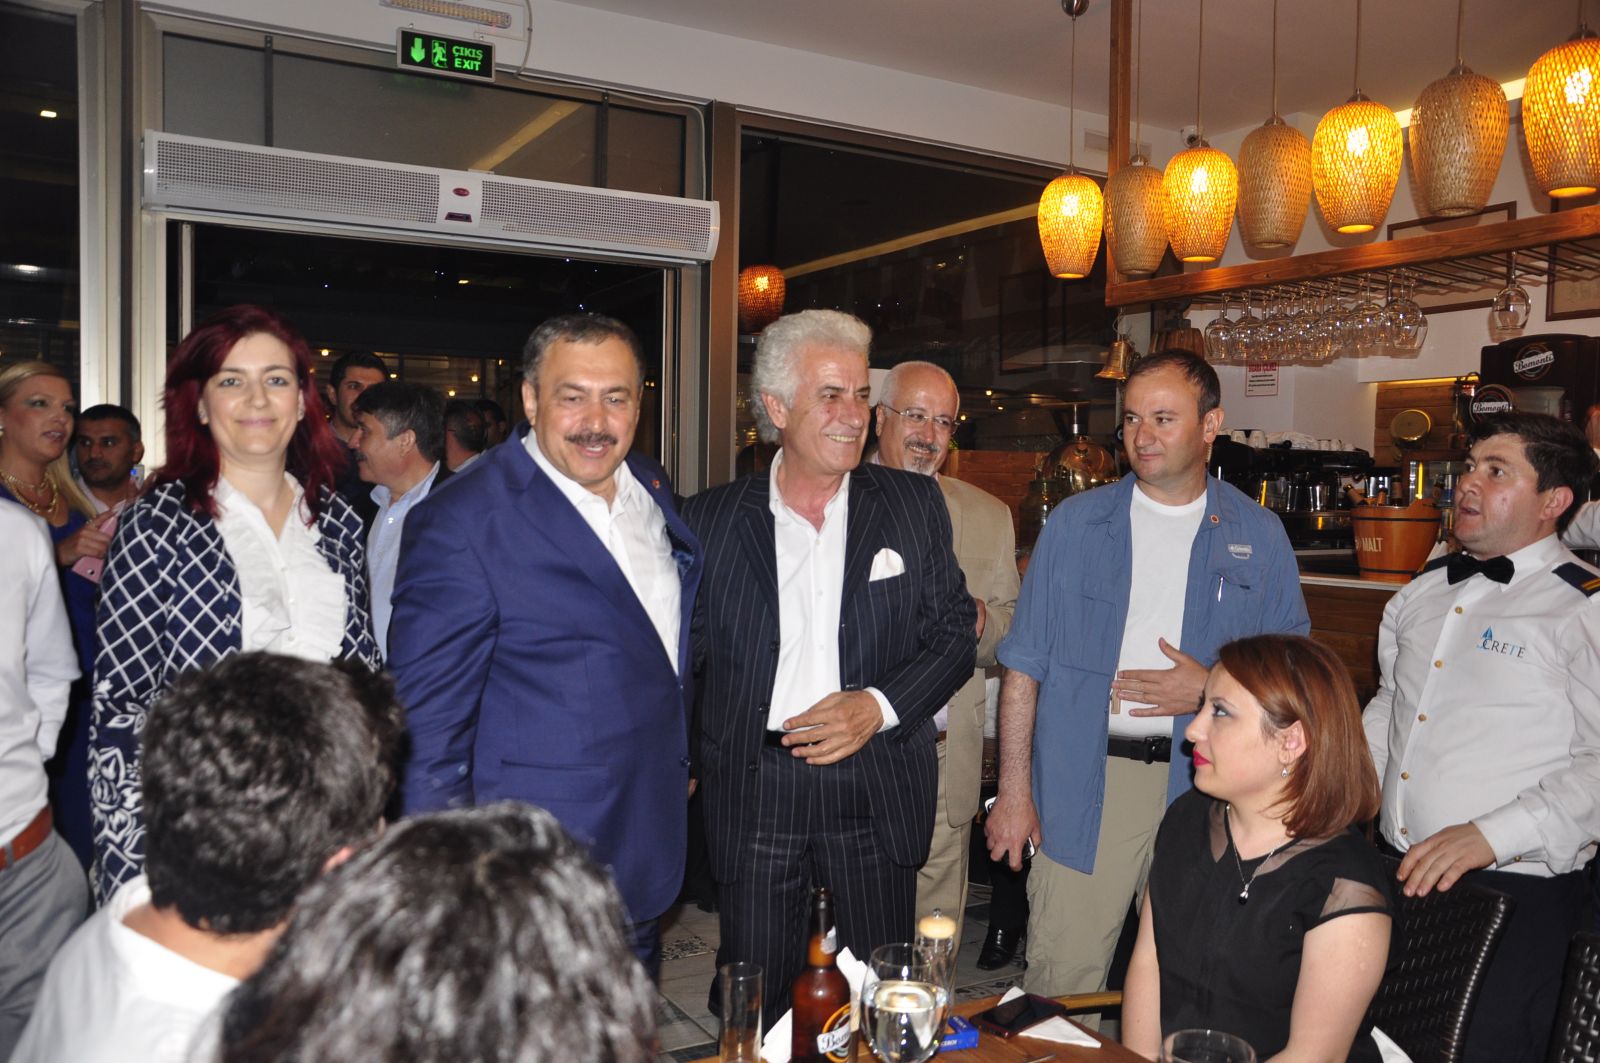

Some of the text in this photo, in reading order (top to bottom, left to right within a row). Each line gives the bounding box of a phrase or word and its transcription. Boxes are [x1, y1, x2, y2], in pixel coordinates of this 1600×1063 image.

[452, 45, 483, 60] ÇIKIŞ
[454, 58, 481, 71] EXIT
[1515, 353, 1554, 372] Bomonti
[1361, 537, 1383, 552] MALT
[1482, 639, 1526, 658] CRETE
